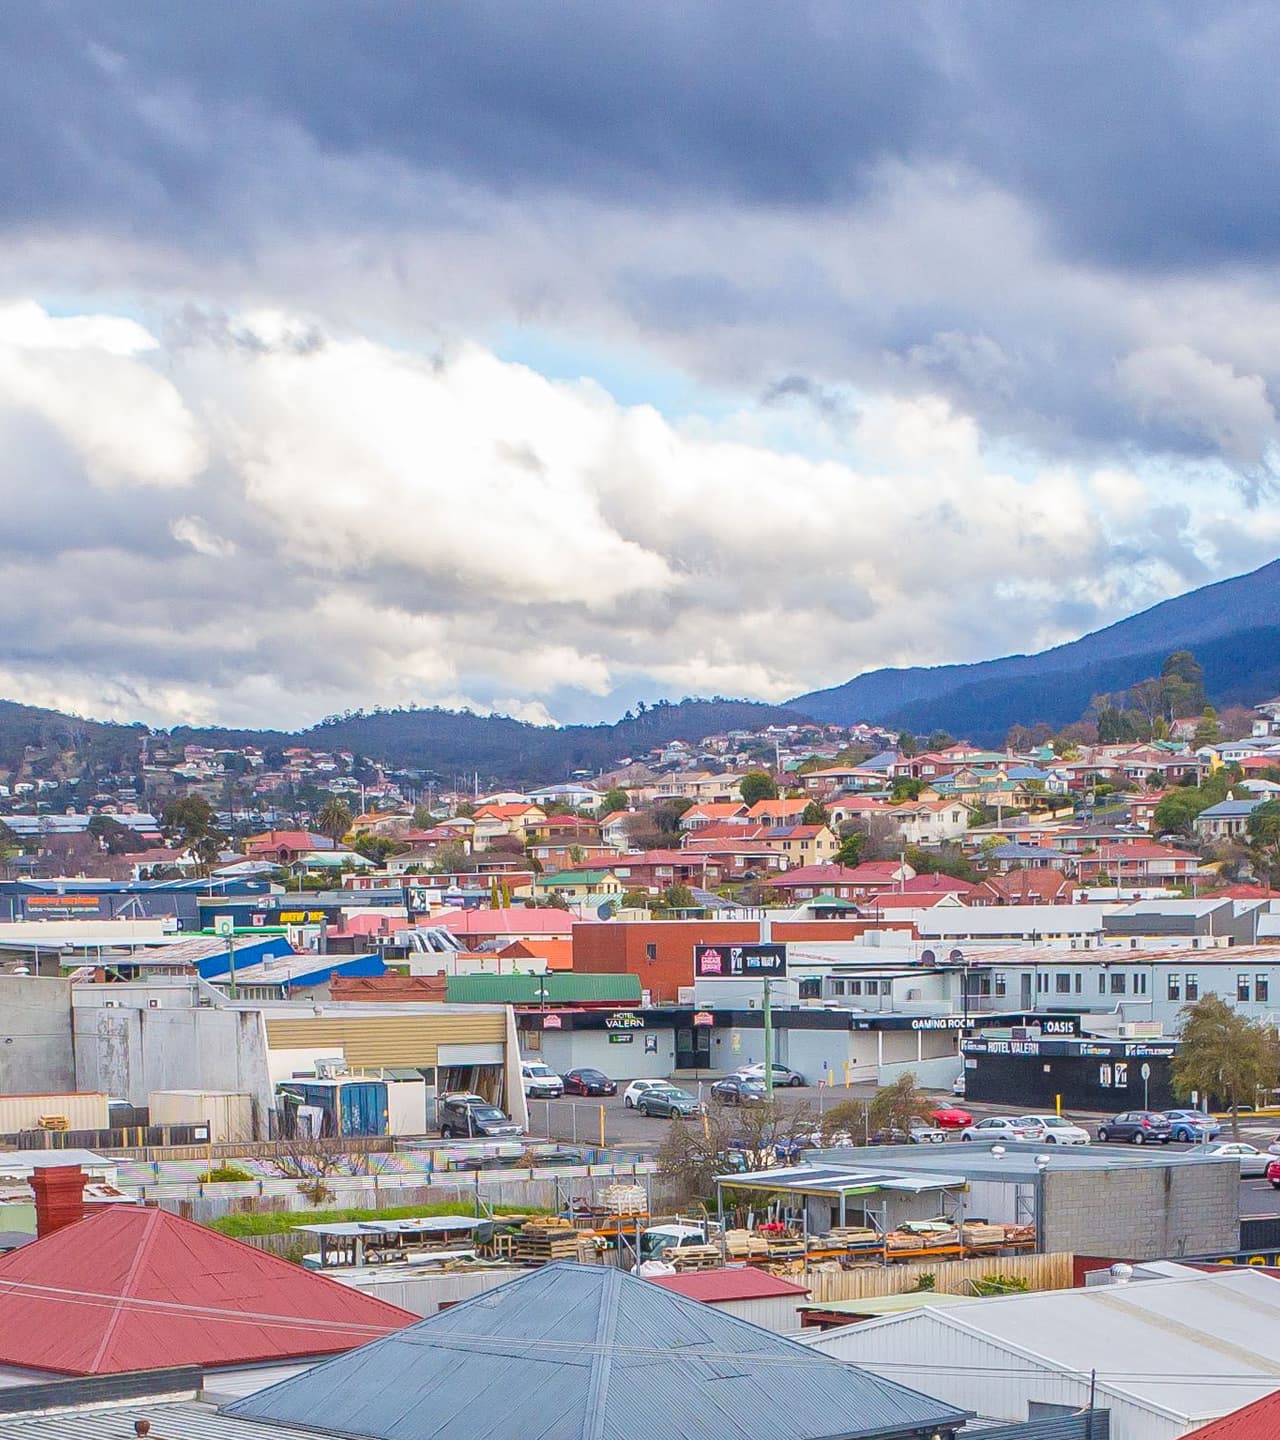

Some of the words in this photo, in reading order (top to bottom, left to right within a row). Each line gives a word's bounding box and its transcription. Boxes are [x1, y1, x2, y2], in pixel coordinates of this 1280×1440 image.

[605, 1018, 644, 1028] VALERN
[911, 1019, 946, 1029] GAMING
[1047, 1021, 1074, 1032] OASIS
[988, 1041, 1010, 1053] HOTEL
[1011, 1042, 1039, 1055] VALERN
